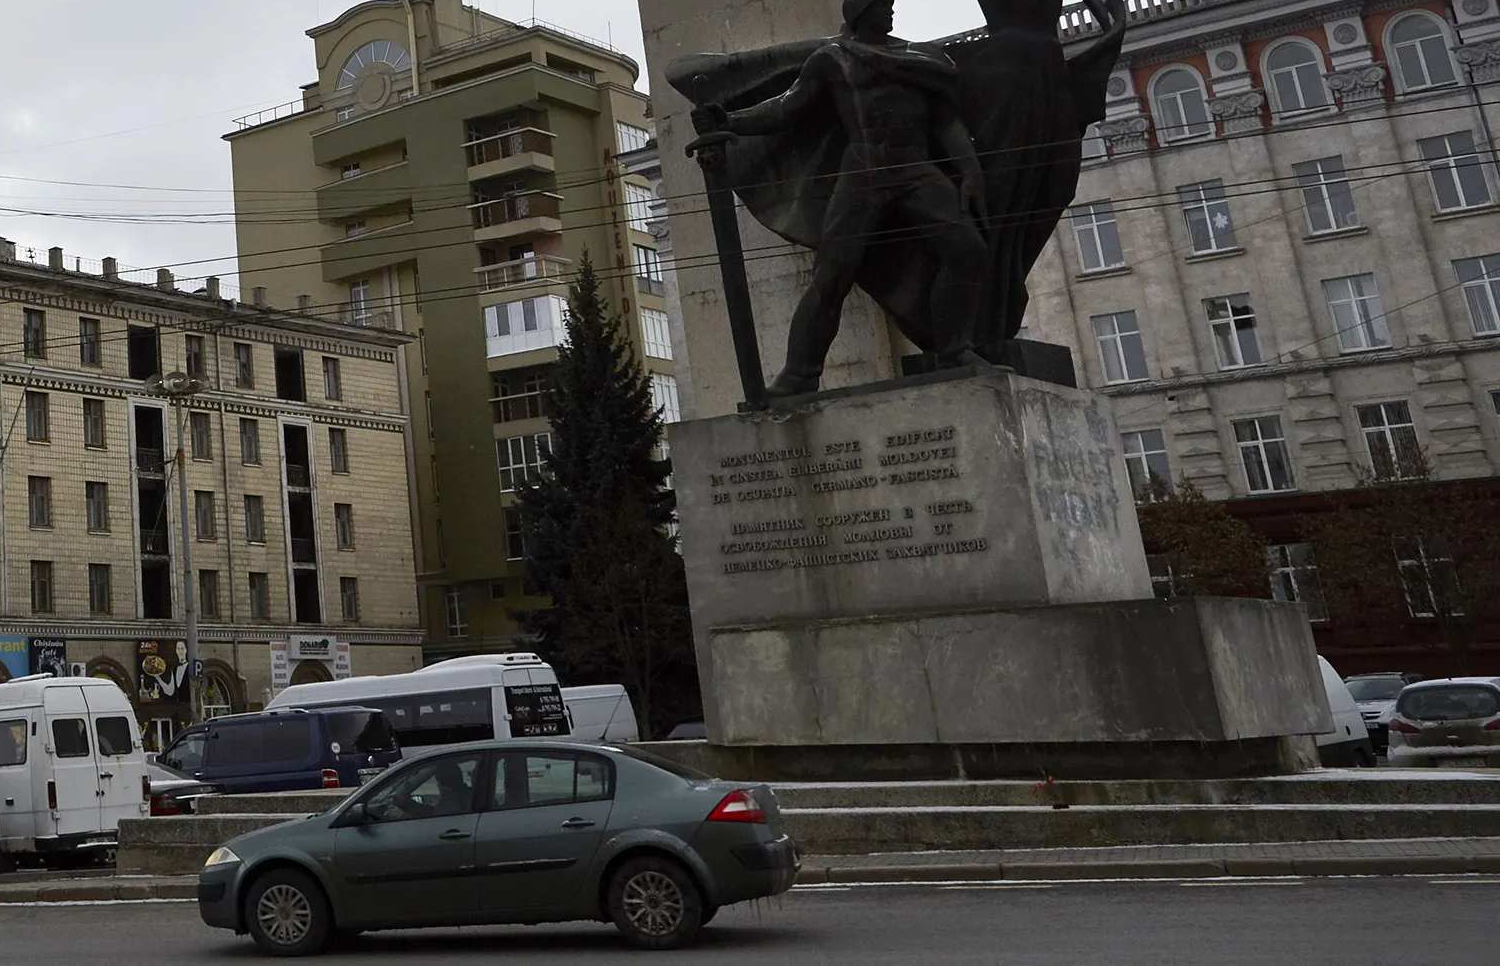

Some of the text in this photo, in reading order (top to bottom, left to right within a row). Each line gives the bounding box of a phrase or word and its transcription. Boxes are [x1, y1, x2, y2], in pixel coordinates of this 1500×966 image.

[721, 427, 956, 468] MONUMENTUL ESTE EDIFICAT
[729, 468, 783, 483] CINSTEA
[879, 447, 956, 467] MOLDOVEI
[712, 493, 730, 504] DE
[732, 501, 973, 535] ПАМЯТНИК СООРУЖЕН В ЧЕСТЬ
[720, 523, 953, 554] ОСВОБОЖДЕНИЯ МОЛДОВЫ ОТ
